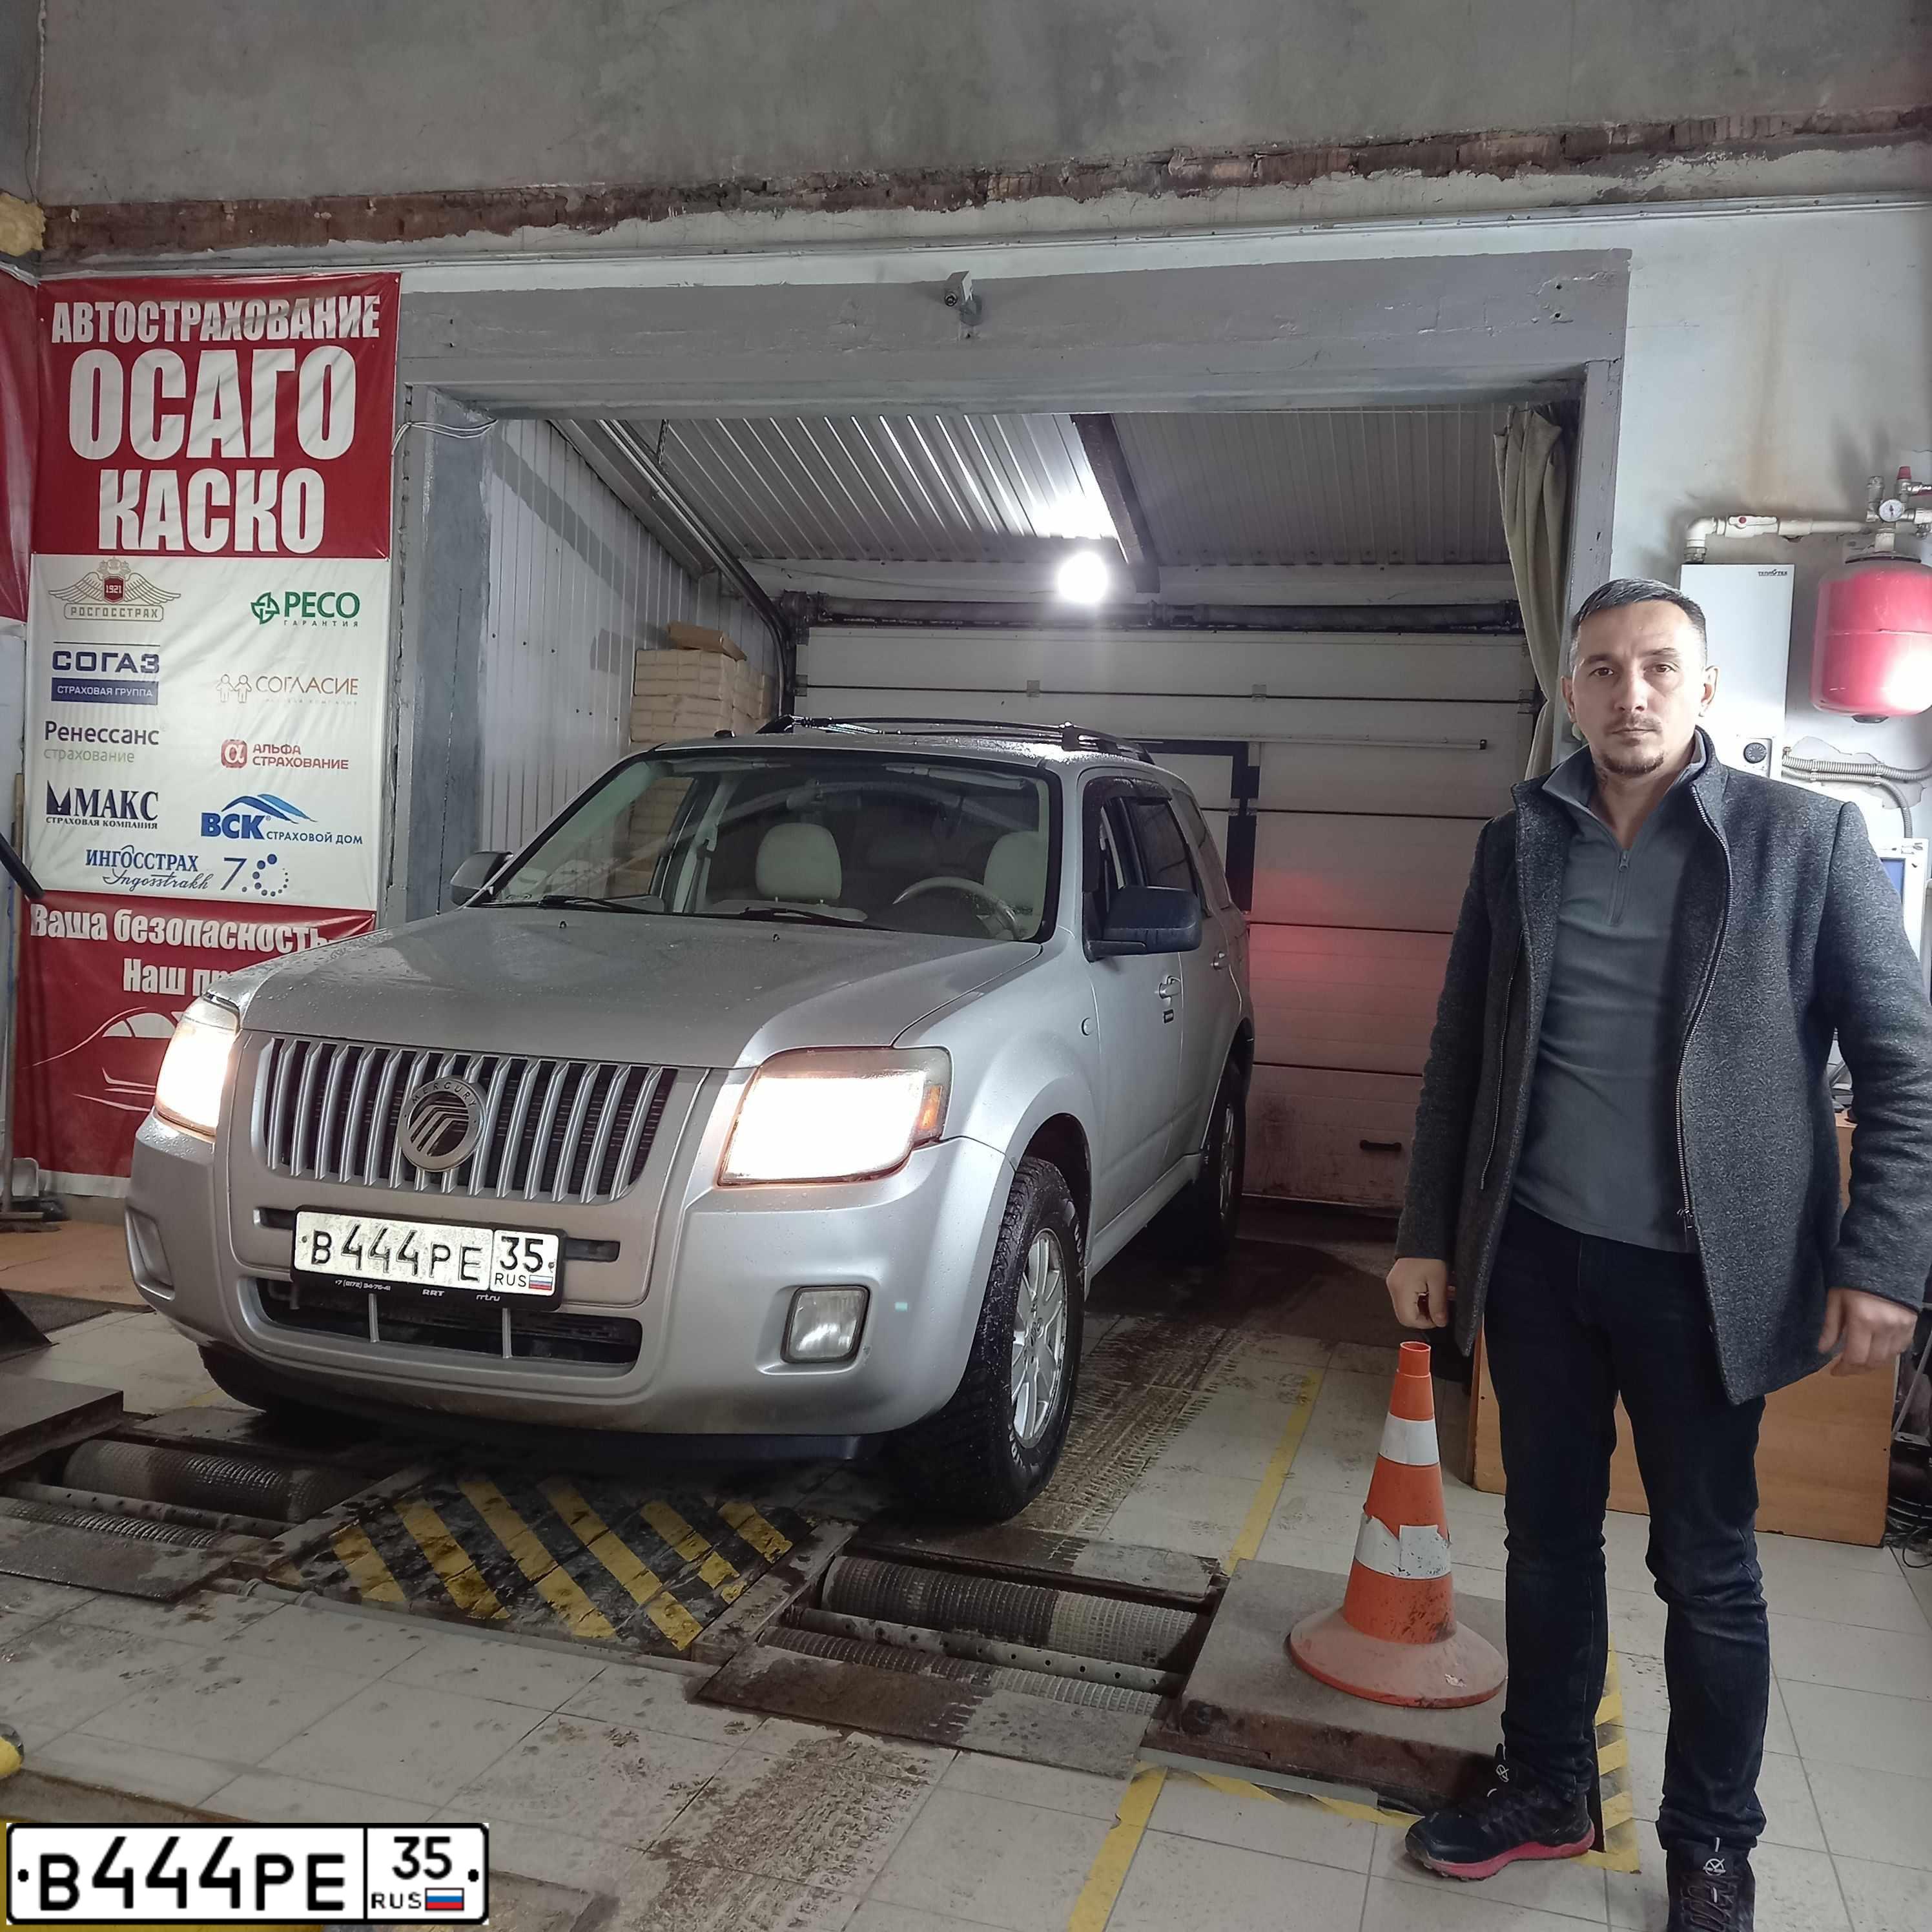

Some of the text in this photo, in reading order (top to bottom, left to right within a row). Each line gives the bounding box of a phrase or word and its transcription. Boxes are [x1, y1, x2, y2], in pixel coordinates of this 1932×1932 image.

[52, 295, 380, 343] АВТОСТРАХОВАНИЕ
[69, 346, 356, 460] ОСАГО
[99, 468, 325, 553] КАСКО
[106, 585, 122, 593] 1921
[70, 606, 159, 618] РОСГОССТРАХ
[284, 591, 360, 619] РЕСО
[52, 650, 159, 673] СОГАЗ
[57, 685, 153, 697] СТРАХОВАЯ ГРУППА
[256, 675, 359, 695] СОГЛАСИЕ
[45, 721, 159, 745] Ренессанс
[43, 748, 135, 763] страхование
[252, 743, 302, 755] АЛЬФА
[252, 755, 349, 770] СТРАХОВАНИЕ
[46, 816, 158, 830] СТРАХОВАЯ КОМПАНИЯ
[266, 830, 363, 845] СТРАХОВОЙ ДОМ
[85, 847, 200, 872] ИНГОССТРАХ
[102, 868, 214, 892] Ingosstrakh
[30, 903, 329, 954] Ваша безопасность
[123, 958, 187, 996] Наш
[411, 1082, 477, 1107] MERCURY
[311, 1224, 544, 1282] В444РЕ 35
[494, 1273, 527, 1288] RUS
